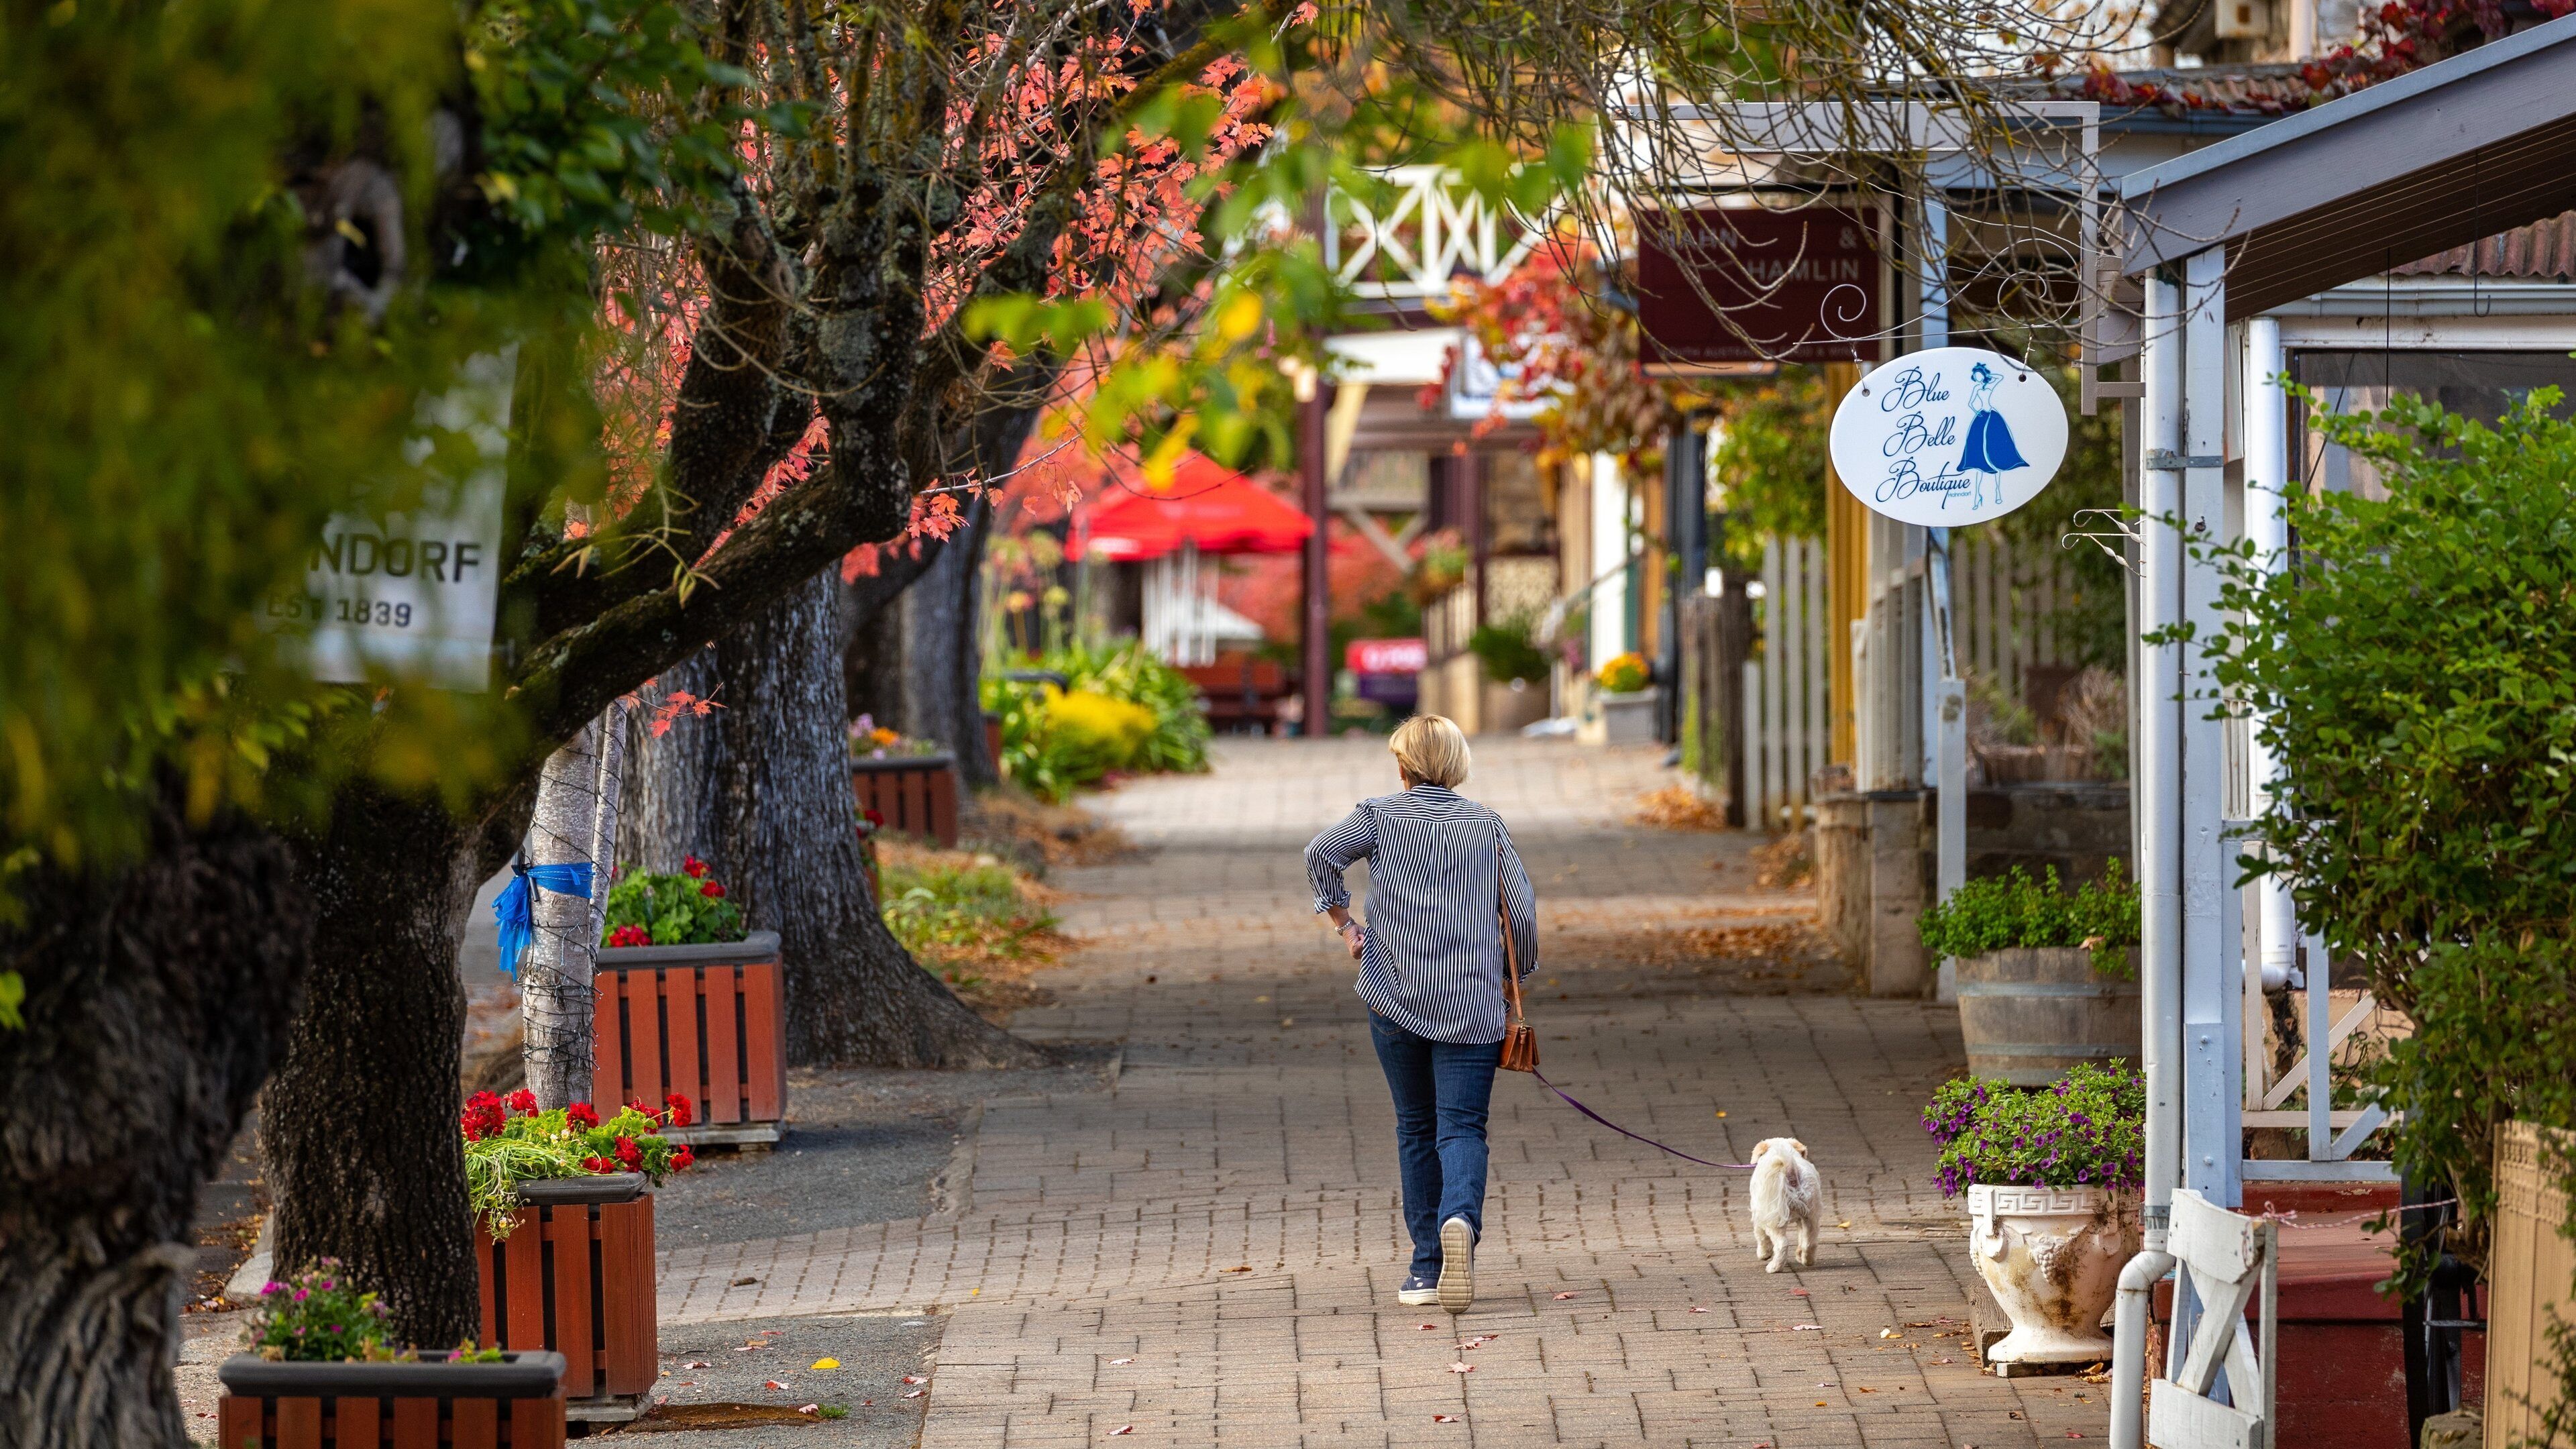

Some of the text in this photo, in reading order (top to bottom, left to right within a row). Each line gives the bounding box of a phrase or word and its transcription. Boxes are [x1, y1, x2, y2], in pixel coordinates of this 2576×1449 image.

[1838, 227, 1858, 250] &
[1747, 258, 1859, 282] HAMLIN
[1881, 366, 1950, 412] Blue
[1883, 411, 1955, 457] Belle
[1876, 456, 1971, 509] Boutique
[336, 598, 413, 628] 1839
